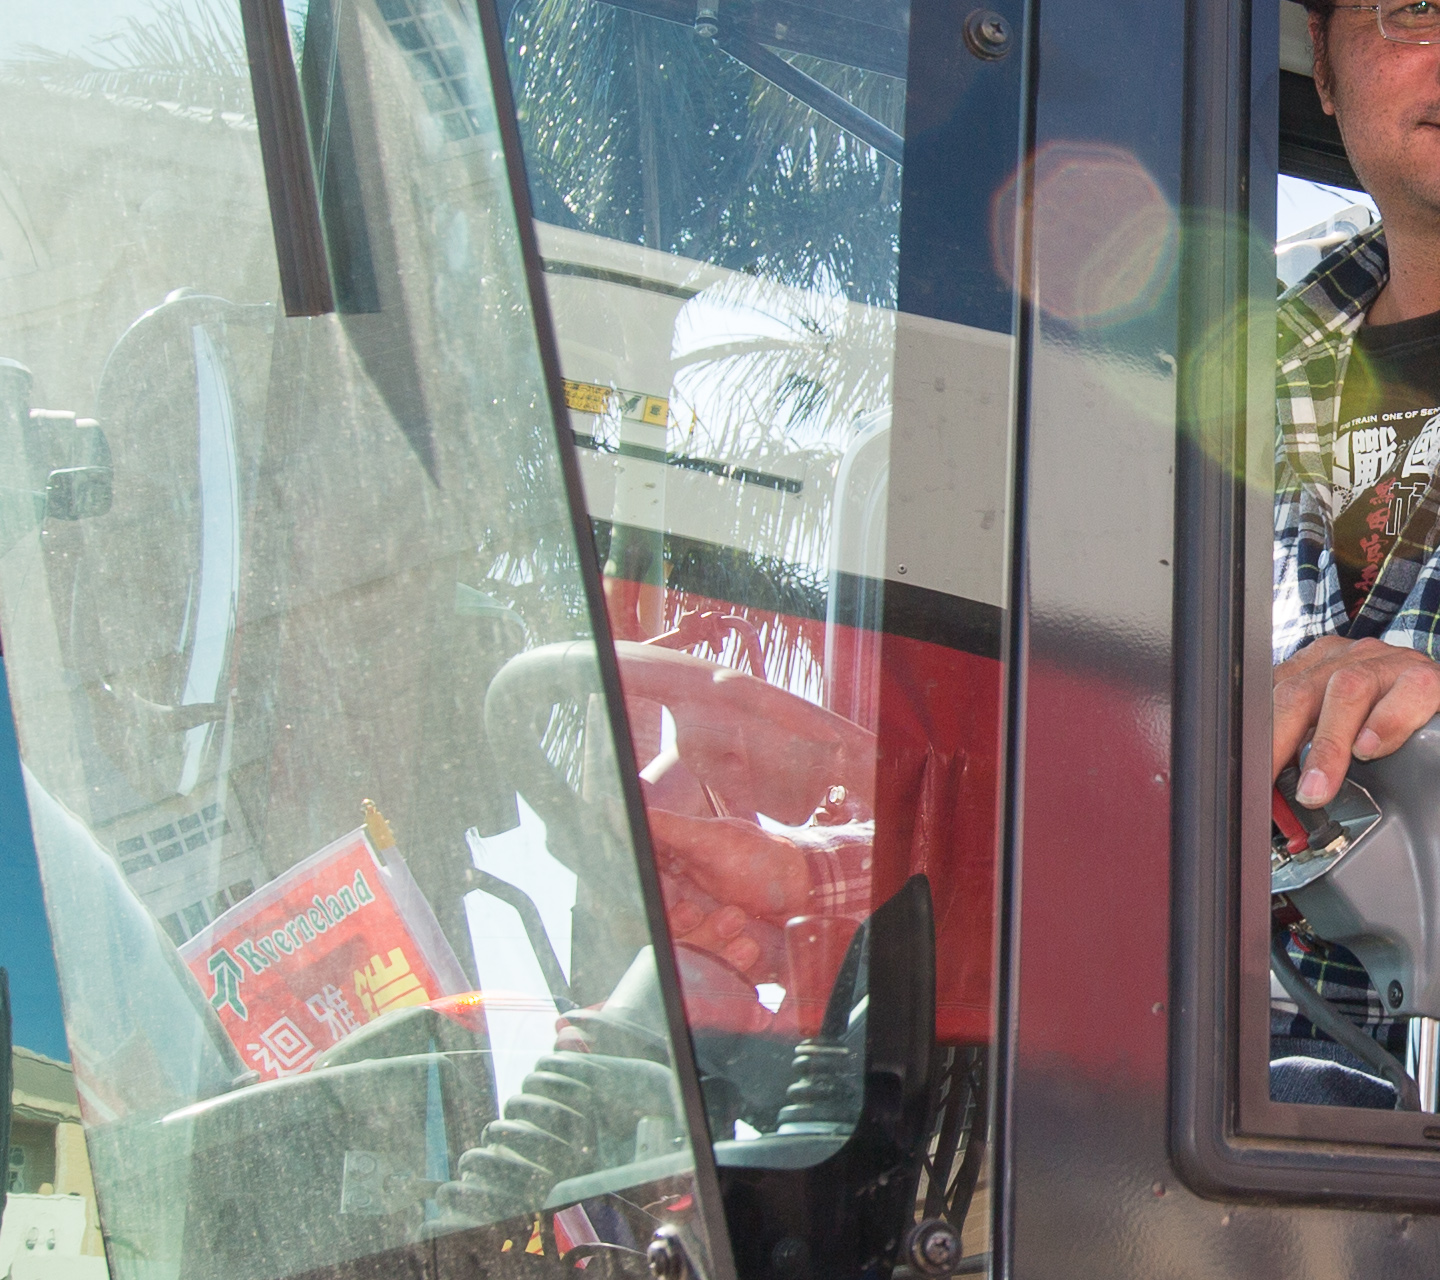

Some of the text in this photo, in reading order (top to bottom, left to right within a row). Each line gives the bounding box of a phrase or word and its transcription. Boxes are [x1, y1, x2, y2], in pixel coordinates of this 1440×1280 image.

[1351, 414, 1378, 426] TRAIN
[1382, 411, 1403, 422] ONE
[1405, 410, 1419, 419] OF
[234, 868, 376, 975] Kverneland
